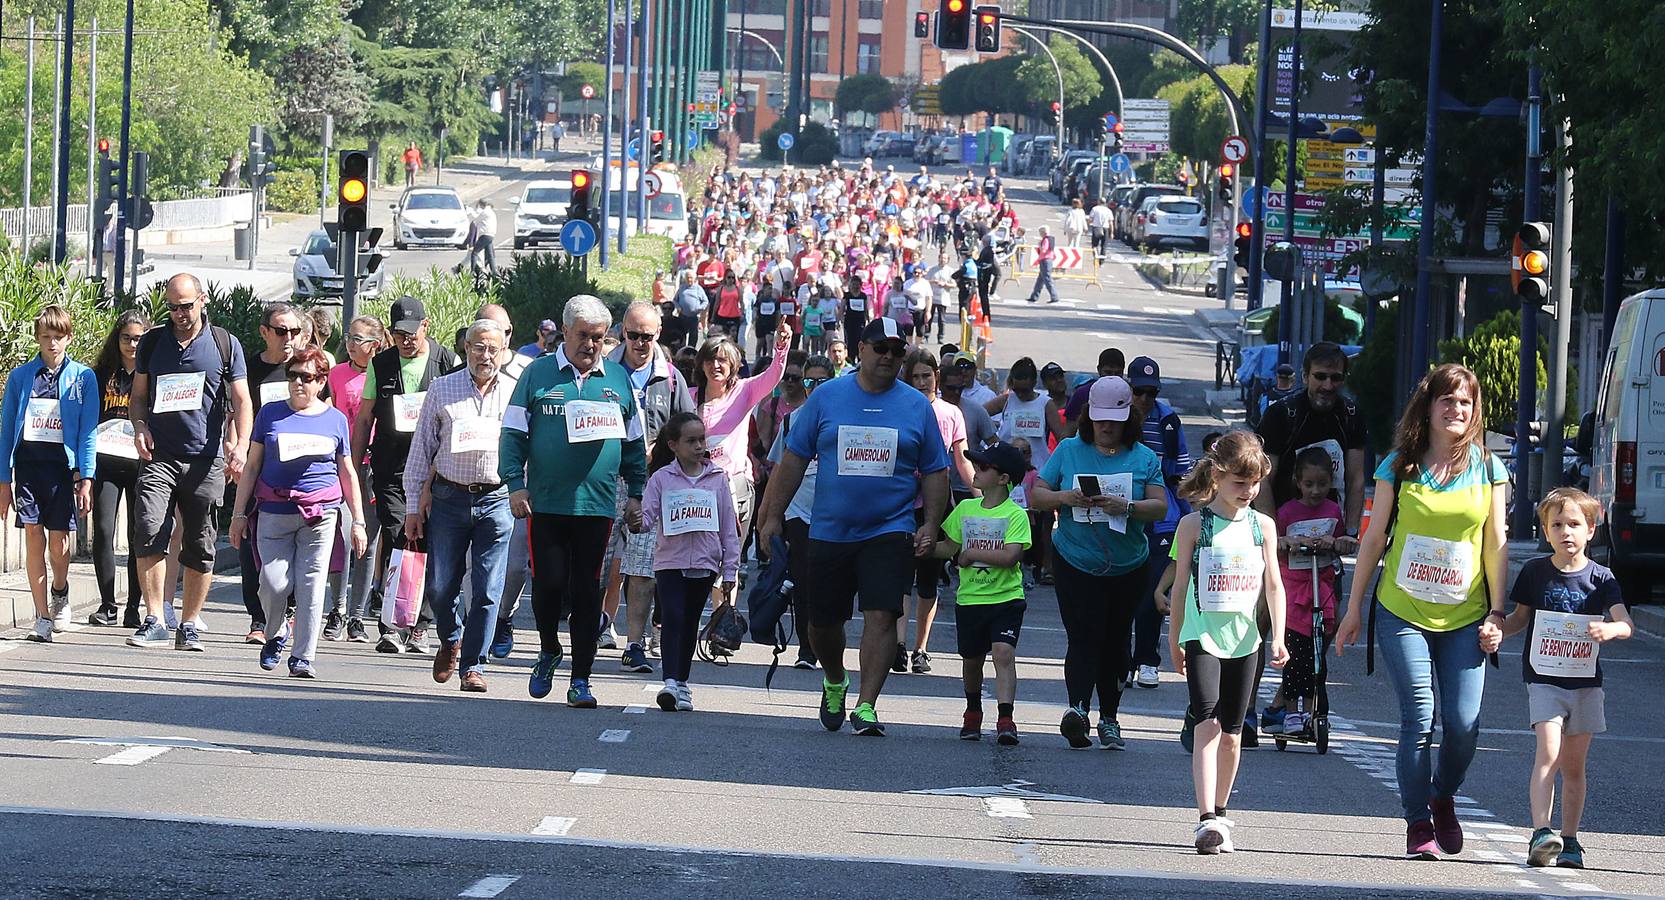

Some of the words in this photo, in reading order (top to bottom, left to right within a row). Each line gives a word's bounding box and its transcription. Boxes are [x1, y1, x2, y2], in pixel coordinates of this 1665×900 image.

[174, 388, 198, 401] ALEGRE
[542, 404, 566, 416] NATI
[45, 417, 62, 430] ALEG
[575, 417, 585, 430] LA
[586, 415, 618, 428] FAMILIA
[845, 447, 891, 463] CAMINEROLMO
[670, 508, 681, 522] LA
[681, 507, 712, 520] FAMILIA
[1407, 562, 1419, 580] DE
[1416, 563, 1442, 583] BENITO
[1440, 568, 1464, 586] GARCIA
[1207, 574, 1217, 592] DE
[1217, 574, 1241, 592] BENITO
[1539, 638, 1550, 656] DE
[1548, 639, 1573, 658] BENITO
[1572, 641, 1593, 659] GARCIA
